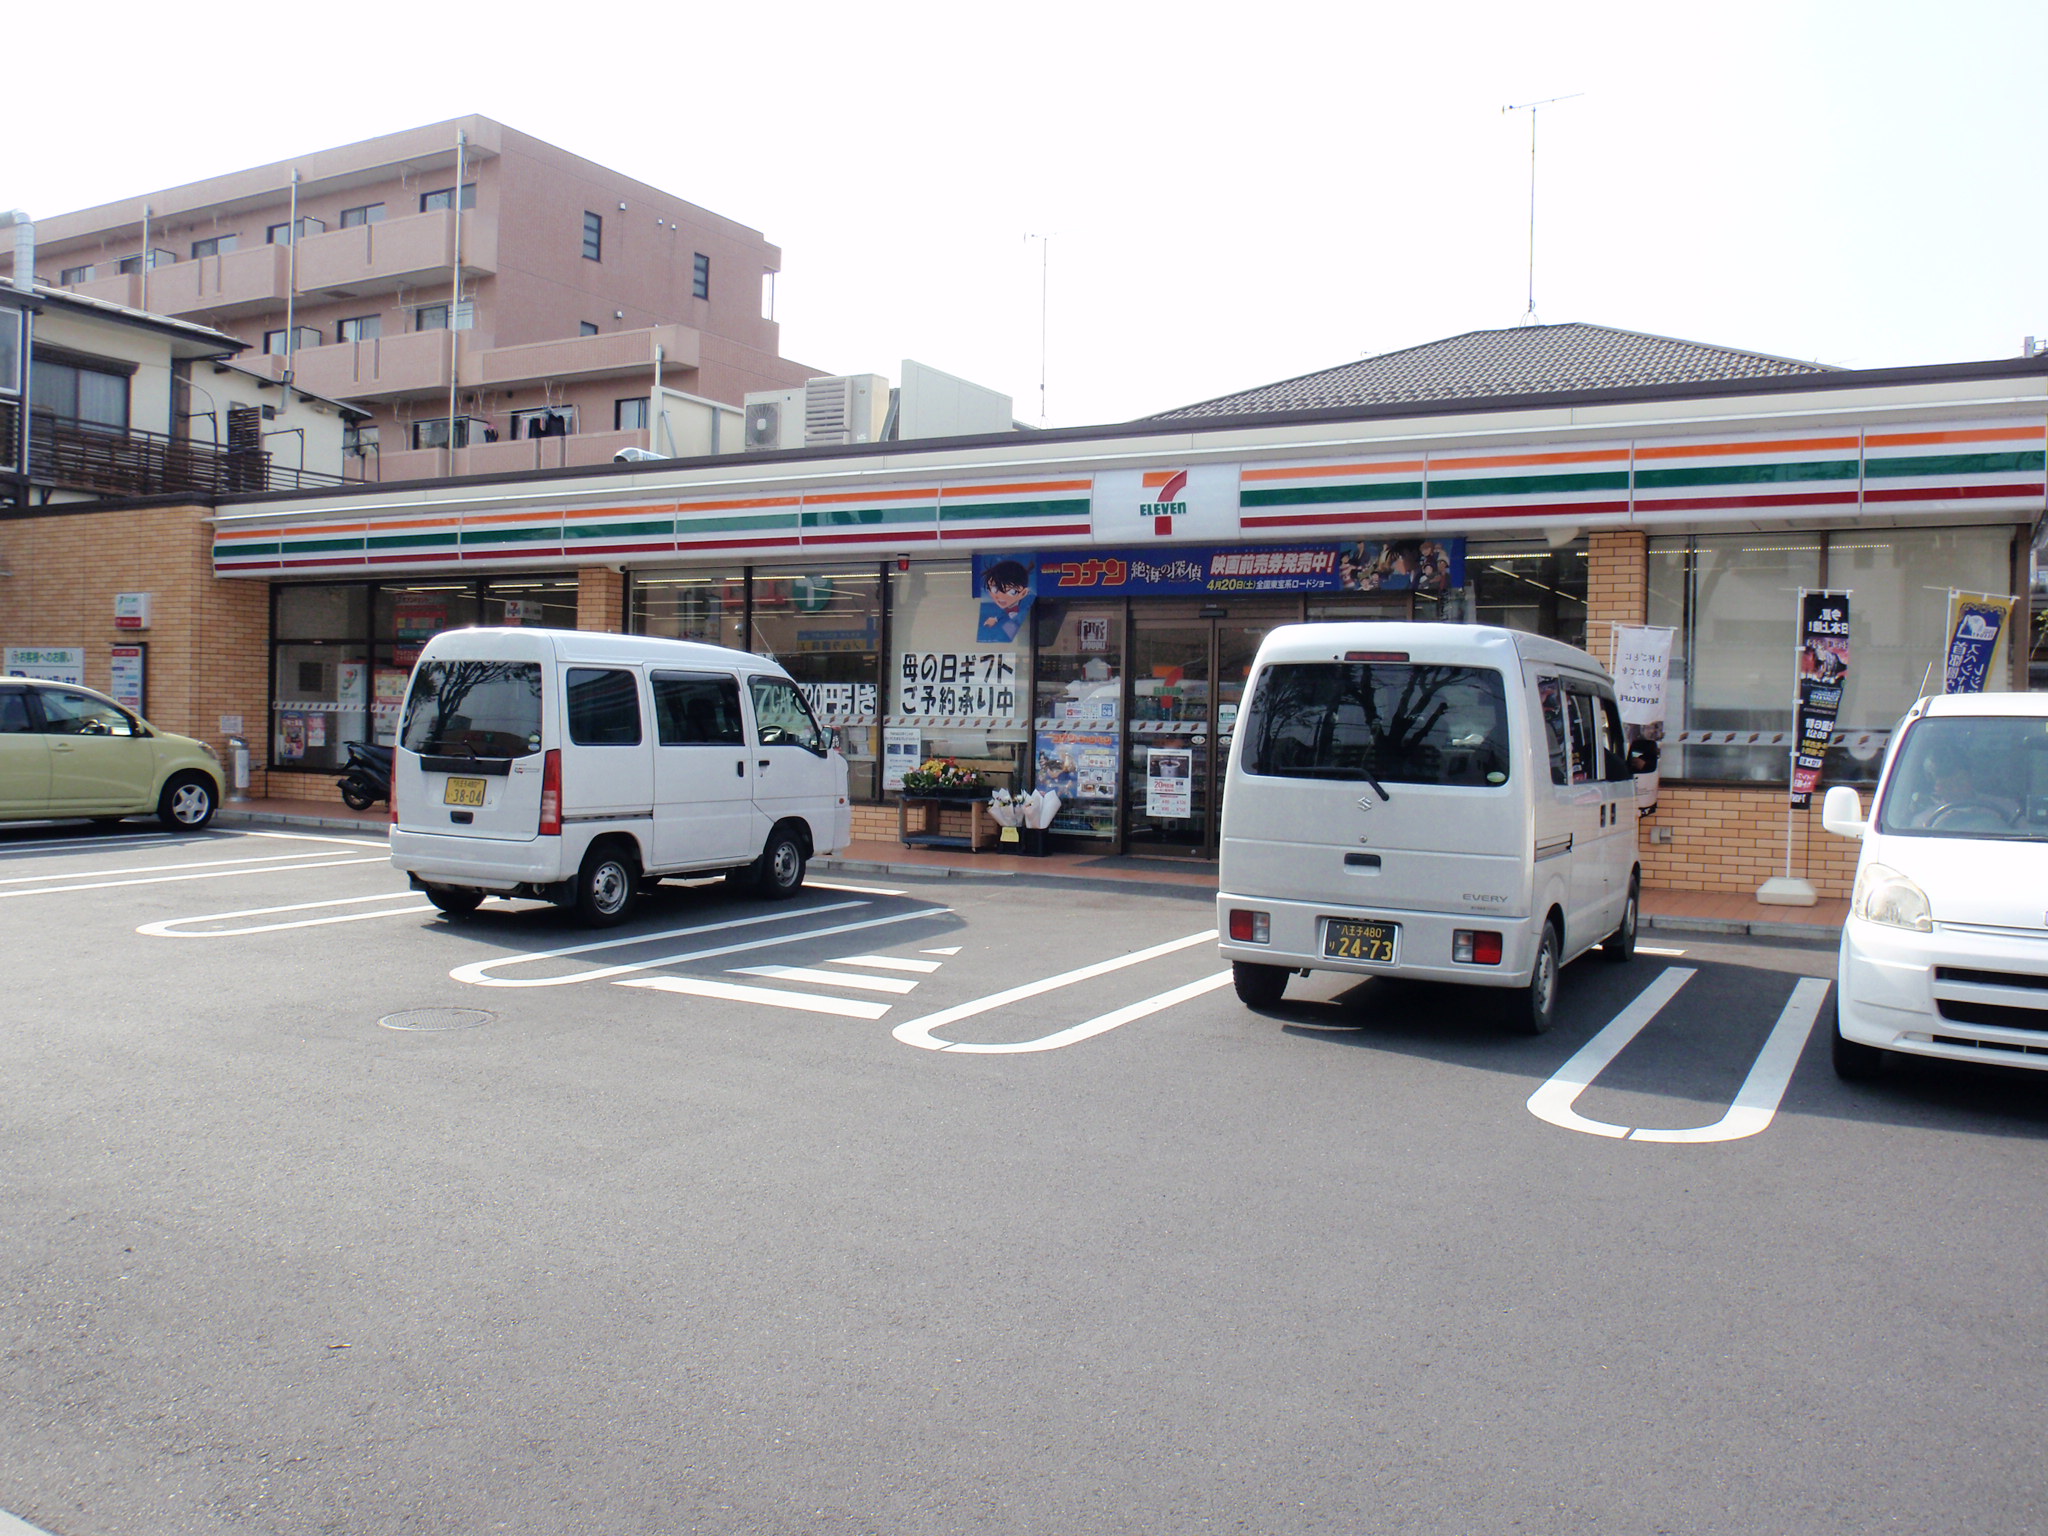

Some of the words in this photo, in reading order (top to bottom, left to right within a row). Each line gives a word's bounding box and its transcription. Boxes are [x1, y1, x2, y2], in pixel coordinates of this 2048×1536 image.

[1142, 470, 1187, 536] 7
[1058, 558, 1127, 587] コナン
[1131, 560, 1202, 583] 絶海の探偵
[902, 653, 1014, 683] 母の日ギフト
[902, 685, 1014, 716] ご予約承り中
[1463, 893, 1508, 902] EVERY
[1338, 937, 1393, 961] 24-73
